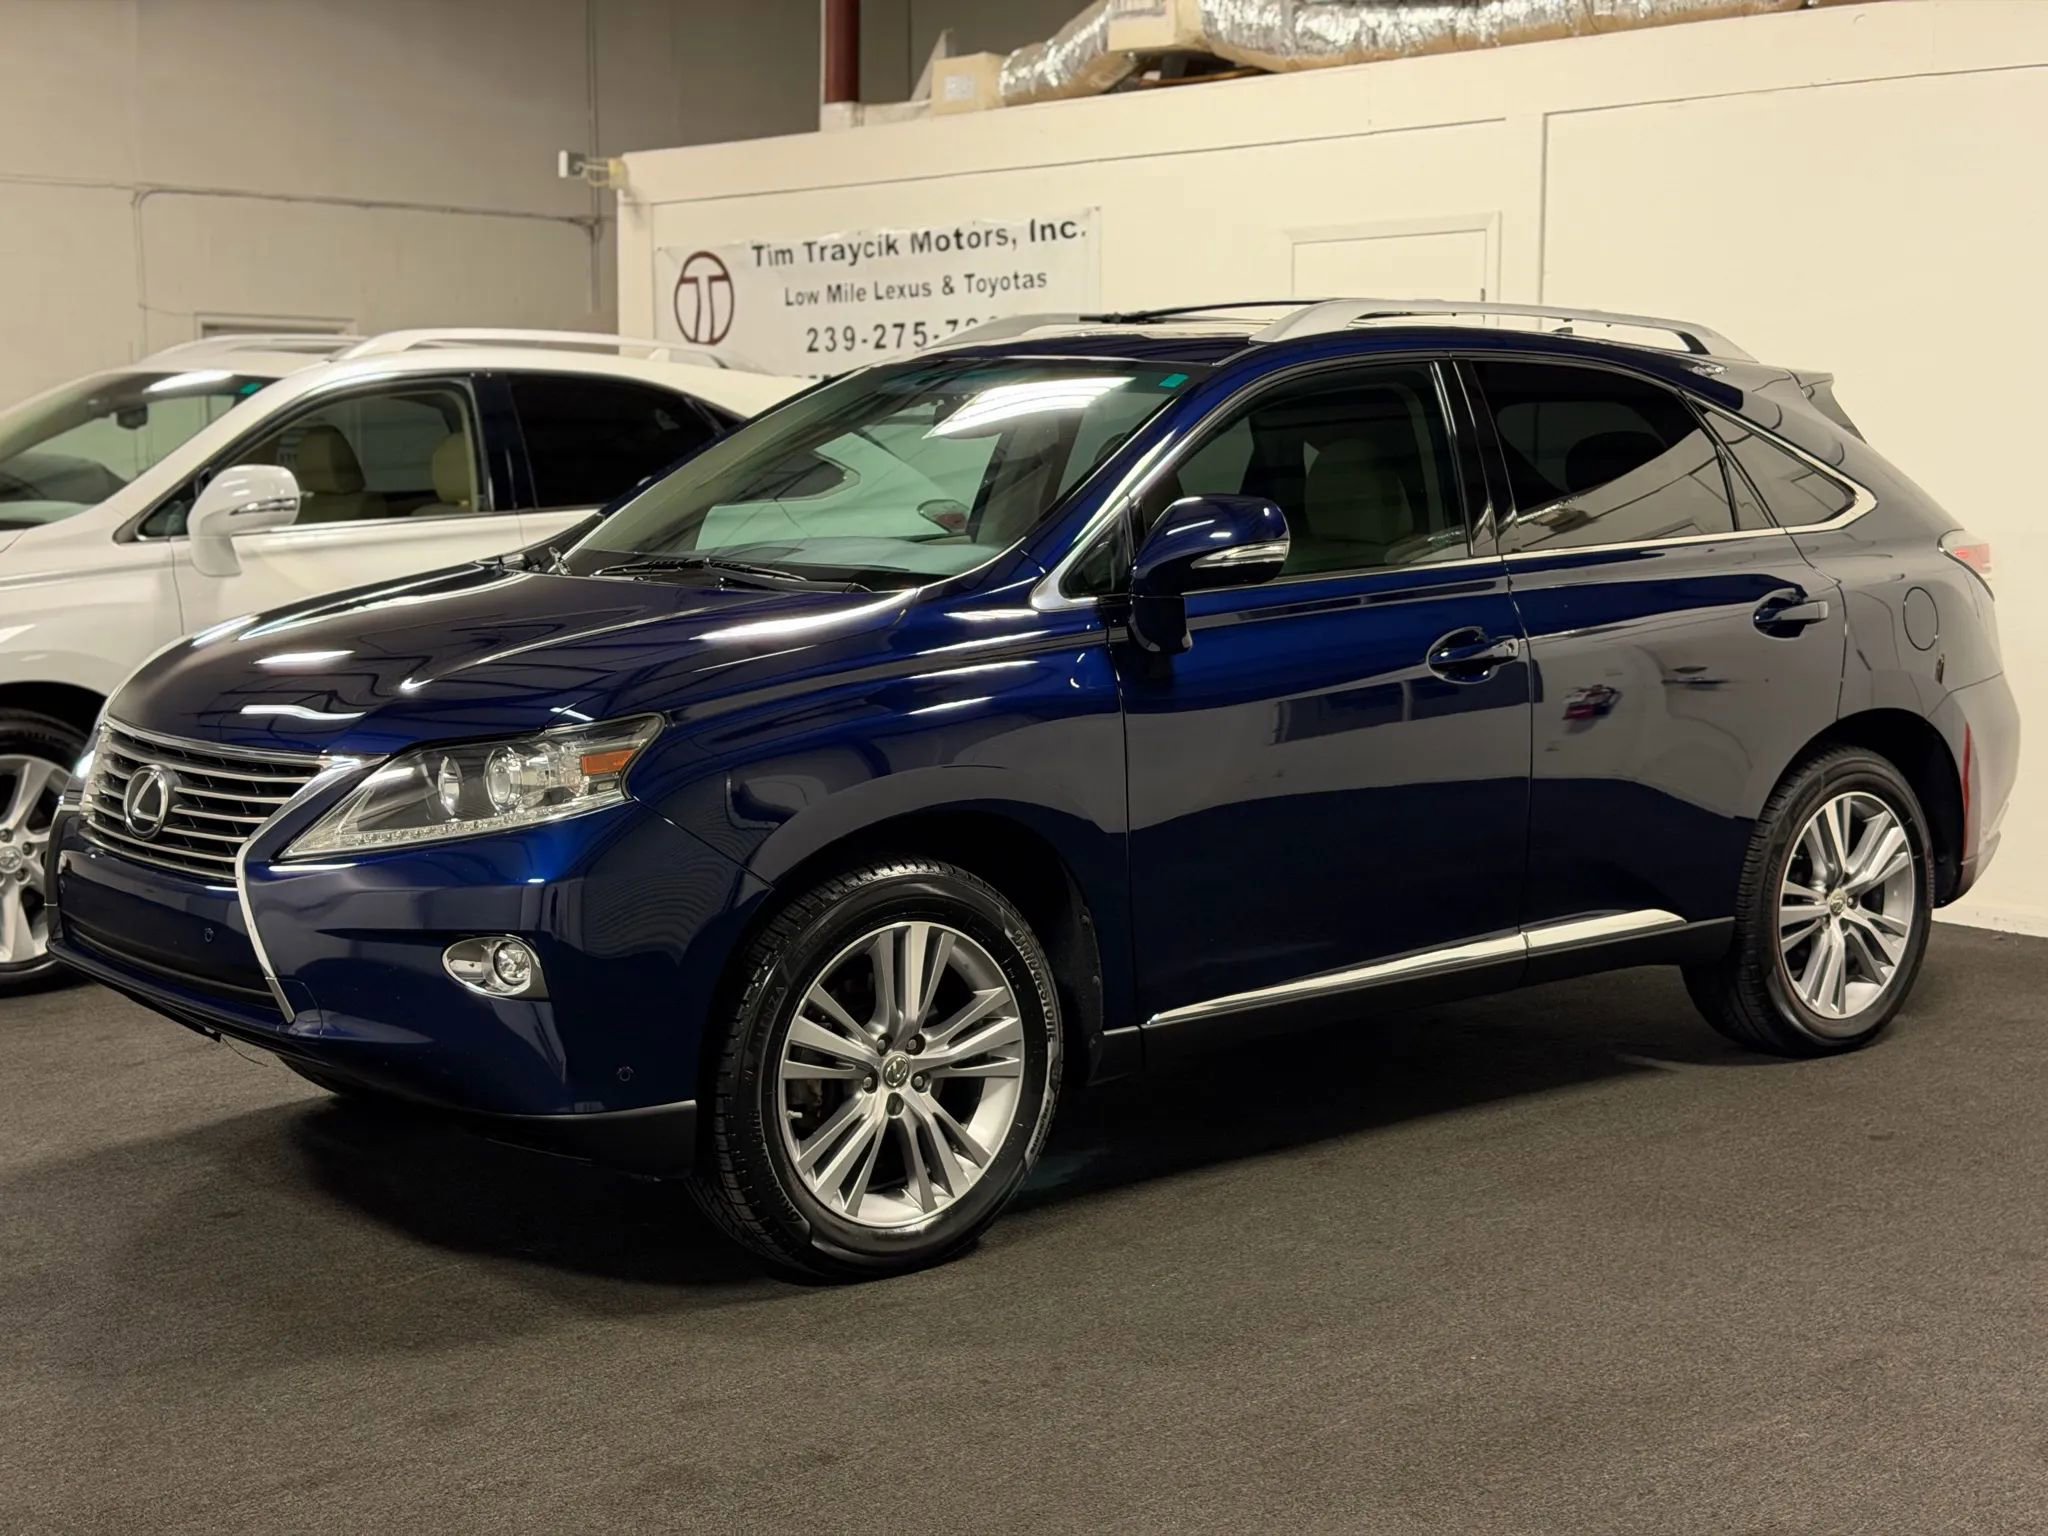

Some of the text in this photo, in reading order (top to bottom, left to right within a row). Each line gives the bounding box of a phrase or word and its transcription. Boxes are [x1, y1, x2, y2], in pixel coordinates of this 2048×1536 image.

[752, 218, 1087, 267] Tim Traycik Motors, Inc.
[784, 271, 1047, 307] Low Mile Lexus & Toyotas
